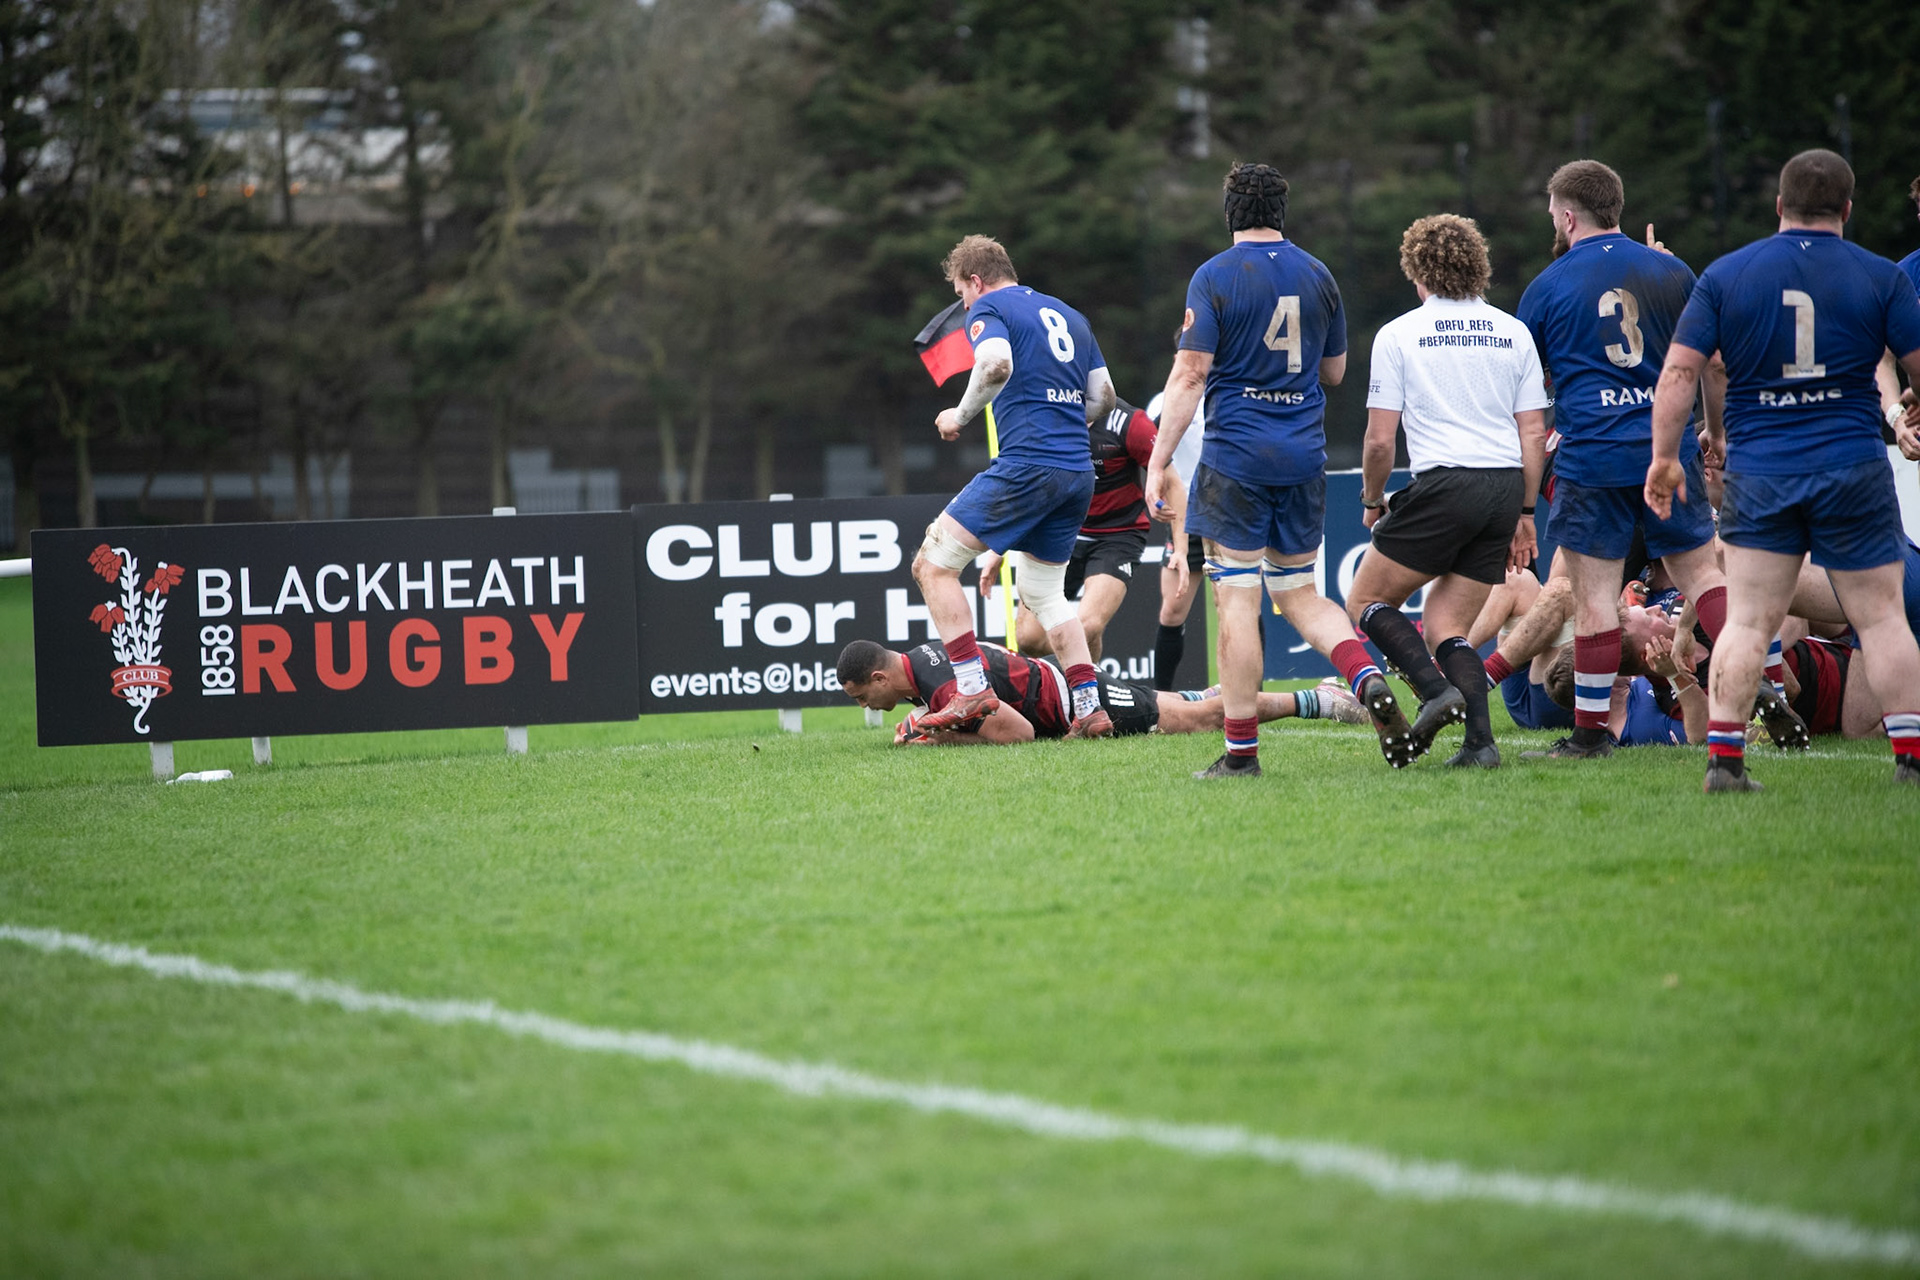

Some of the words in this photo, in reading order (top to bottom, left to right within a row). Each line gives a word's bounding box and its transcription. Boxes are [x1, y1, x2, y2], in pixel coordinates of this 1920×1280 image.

[1039, 307, 1075, 363] 8
[1263, 295, 1302, 373] 4
[1419, 335, 1513, 349] #BEPARTOFTHETEAM
[1435, 320, 1494, 332] @RFU_REFS
[1598, 288, 1644, 368] 3
[1782, 289, 1826, 378] 1
[1046, 388, 1083, 404] RAMS
[1242, 386, 1305, 405] RAMS
[1599, 386, 1655, 407] RAM
[1758, 388, 1843, 407] RAMS
[646, 519, 902, 581] CLUB
[197, 555, 585, 617] BLACKHEATH
[715, 591, 856, 648] for
[123, 671, 159, 682] CLUB
[200, 624, 236, 696] 1858
[242, 612, 585, 694] RUGBY
